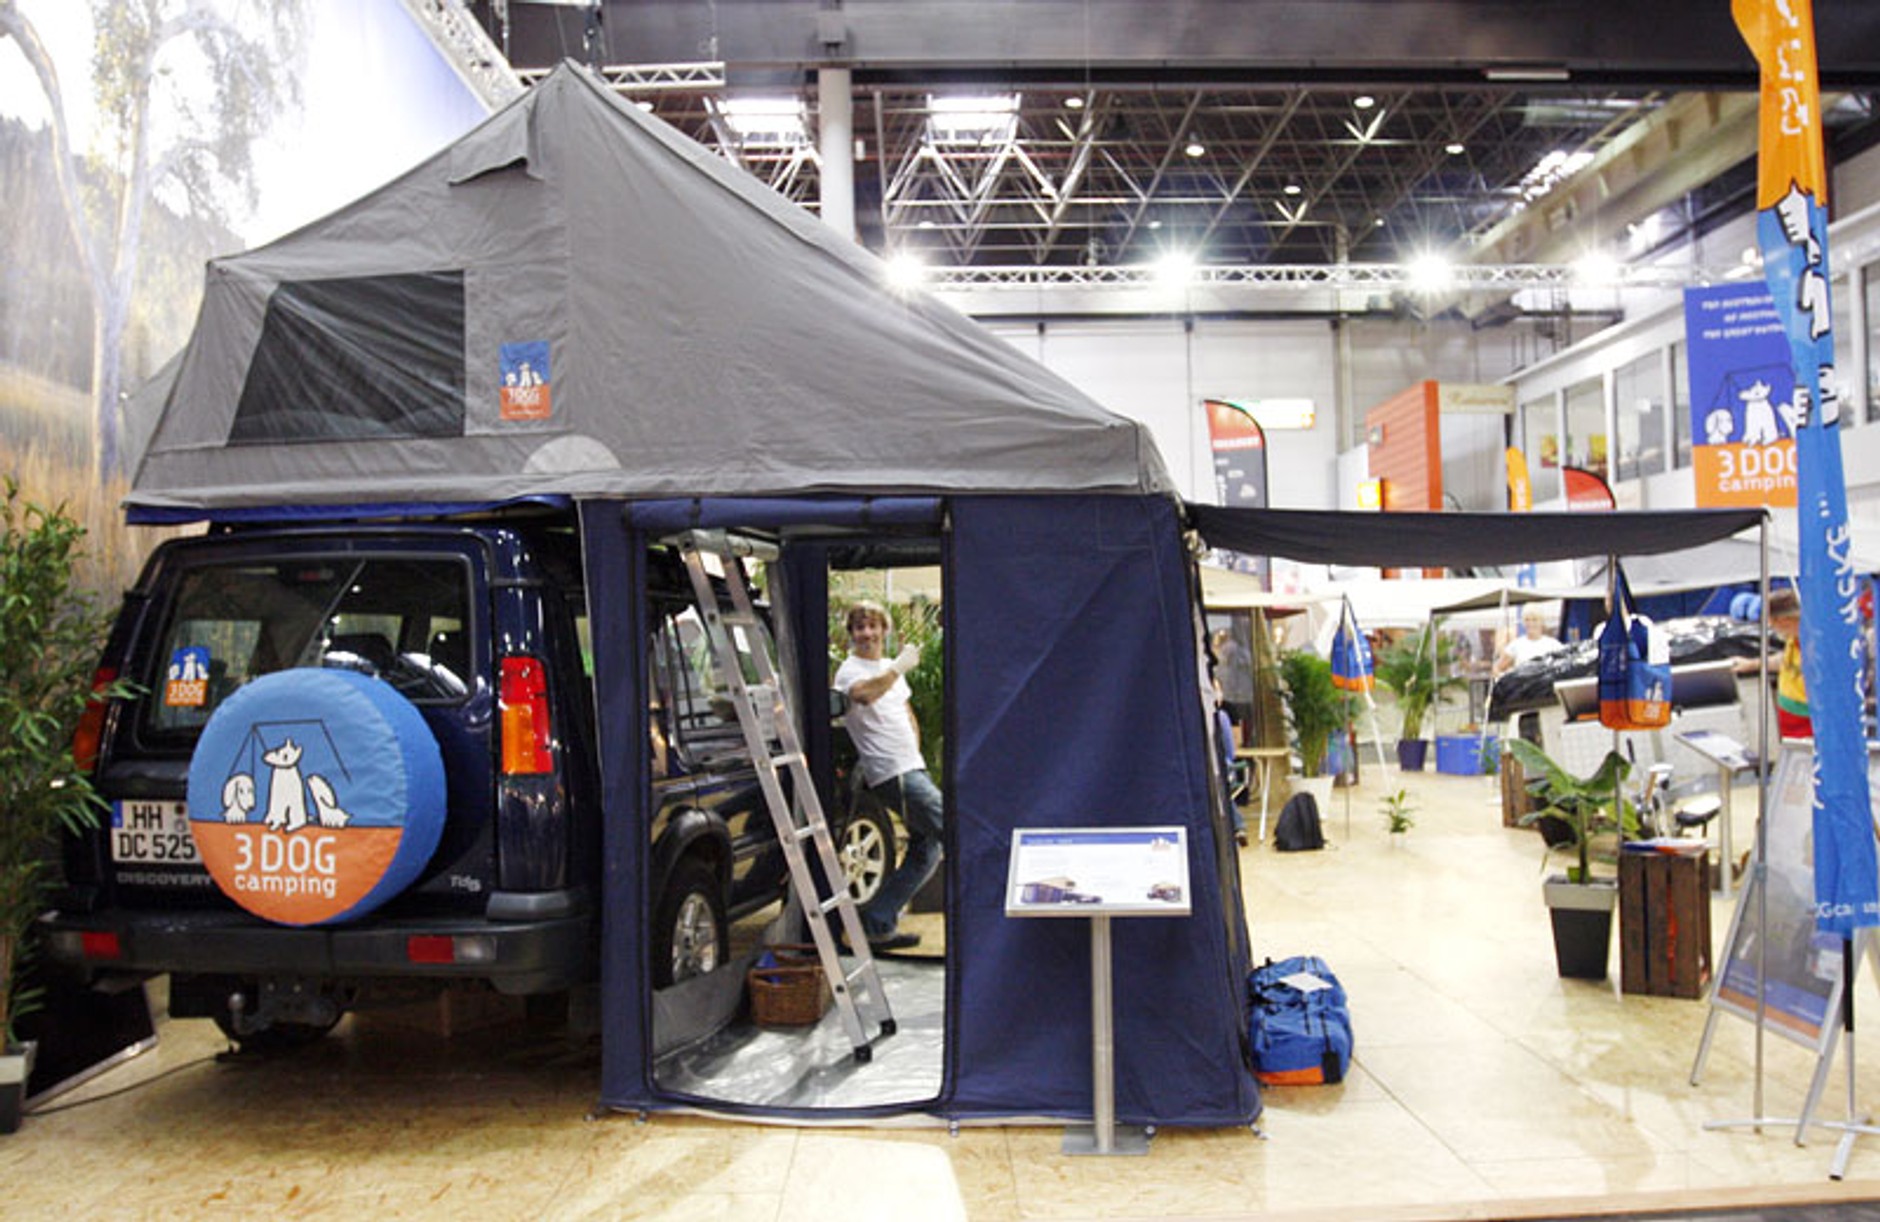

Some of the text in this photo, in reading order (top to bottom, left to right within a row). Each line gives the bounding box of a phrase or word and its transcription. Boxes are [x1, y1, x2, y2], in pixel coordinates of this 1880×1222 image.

[1718, 474, 1797, 495] campin
[132, 804, 163, 830] HH
[118, 833, 197, 859] DC 525
[234, 873, 337, 899] camping
